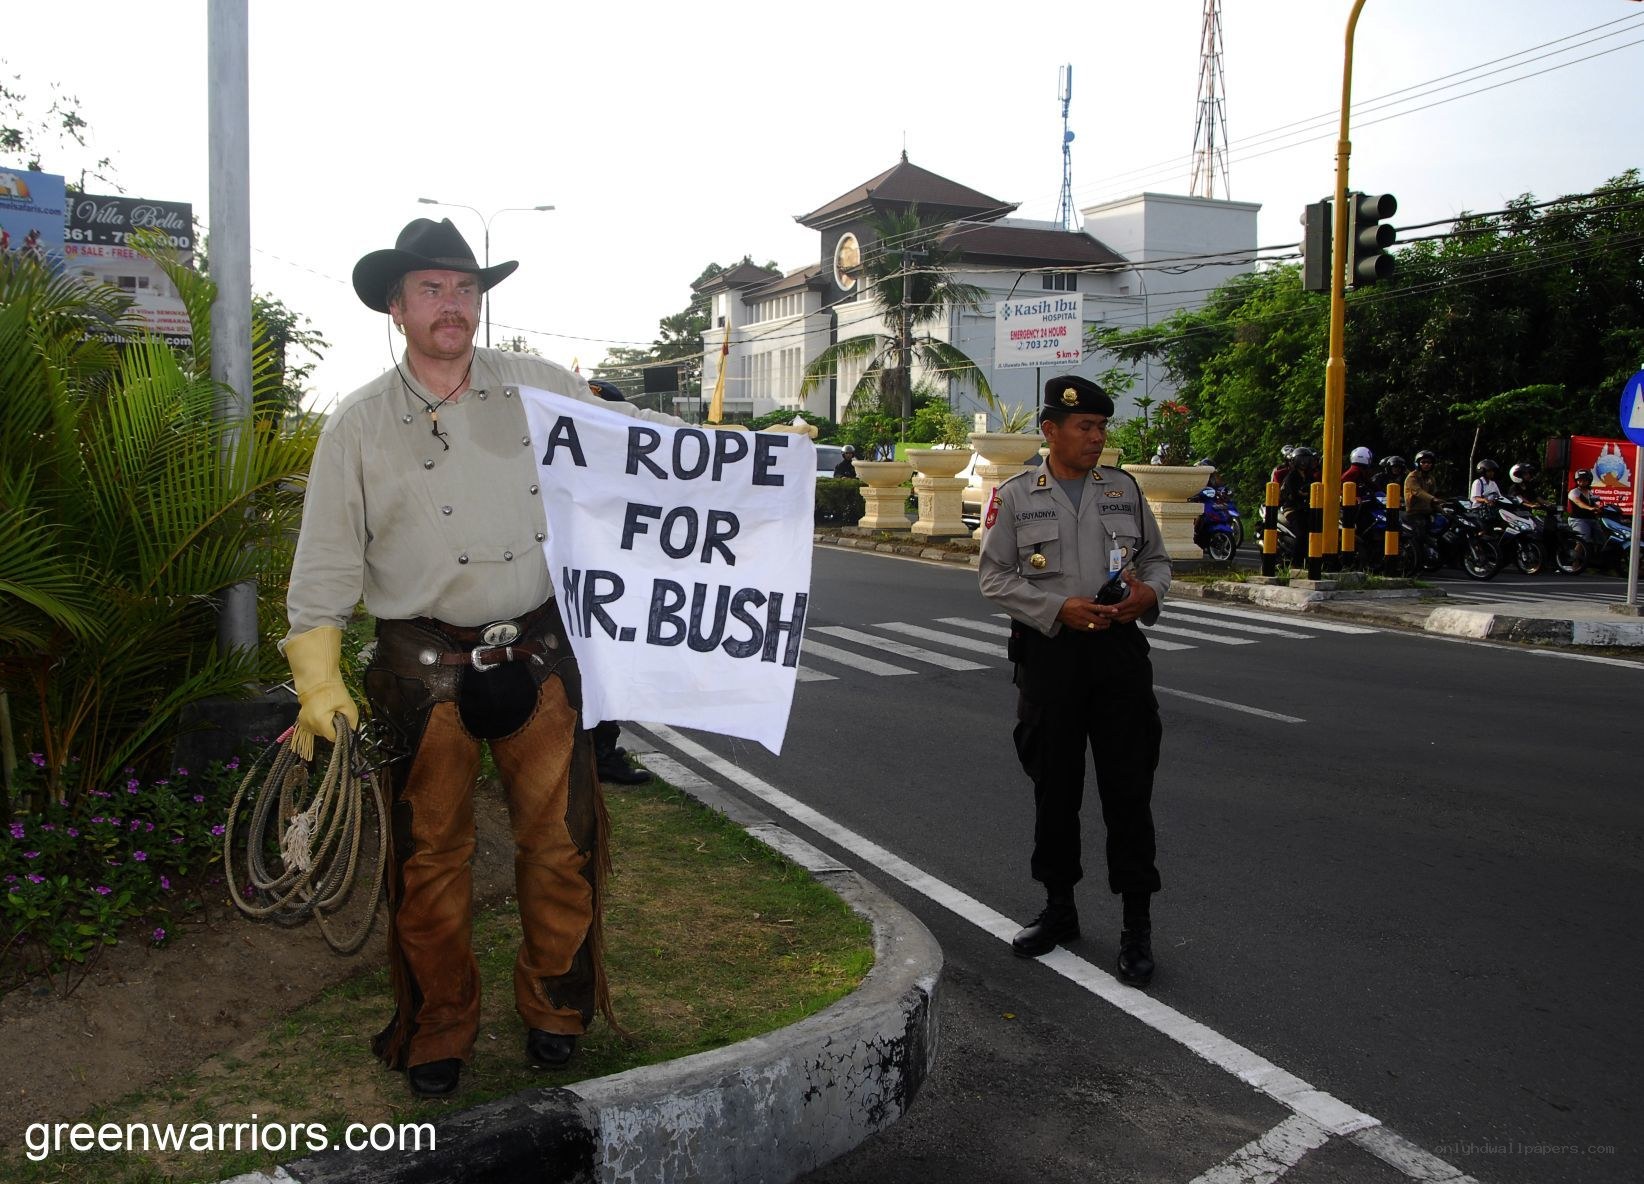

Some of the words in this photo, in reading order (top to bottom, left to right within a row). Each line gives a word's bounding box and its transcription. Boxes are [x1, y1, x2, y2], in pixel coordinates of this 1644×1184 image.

[0, 203, 61, 214] melsafaris.com
[77, 200, 124, 225] Villa
[130, 205, 185, 230] Bella
[65, 245, 78, 256] OR
[81, 246, 104, 257] SALE
[112, 248, 135, 259] FREE
[1014, 300, 1051, 316] Kasih
[1055, 298, 1077, 313] Ibu
[1042, 312, 1077, 322] HOSPITAL
[1010, 328, 1040, 340] EMERGENCY
[1040, 327, 1048, 338] 24
[1048, 326, 1067, 337] HOURS
[1026, 339, 1041, 349] 703
[1043, 338, 1059, 348] 270
[1062, 350, 1072, 358] km
[542, 416, 588, 467] A
[624, 425, 789, 487] ROPE
[1102, 504, 1132, 513] POLISI
[620, 502, 741, 567] FOR
[562, 566, 637, 642] MR.
[646, 578, 808, 668] BUSH
